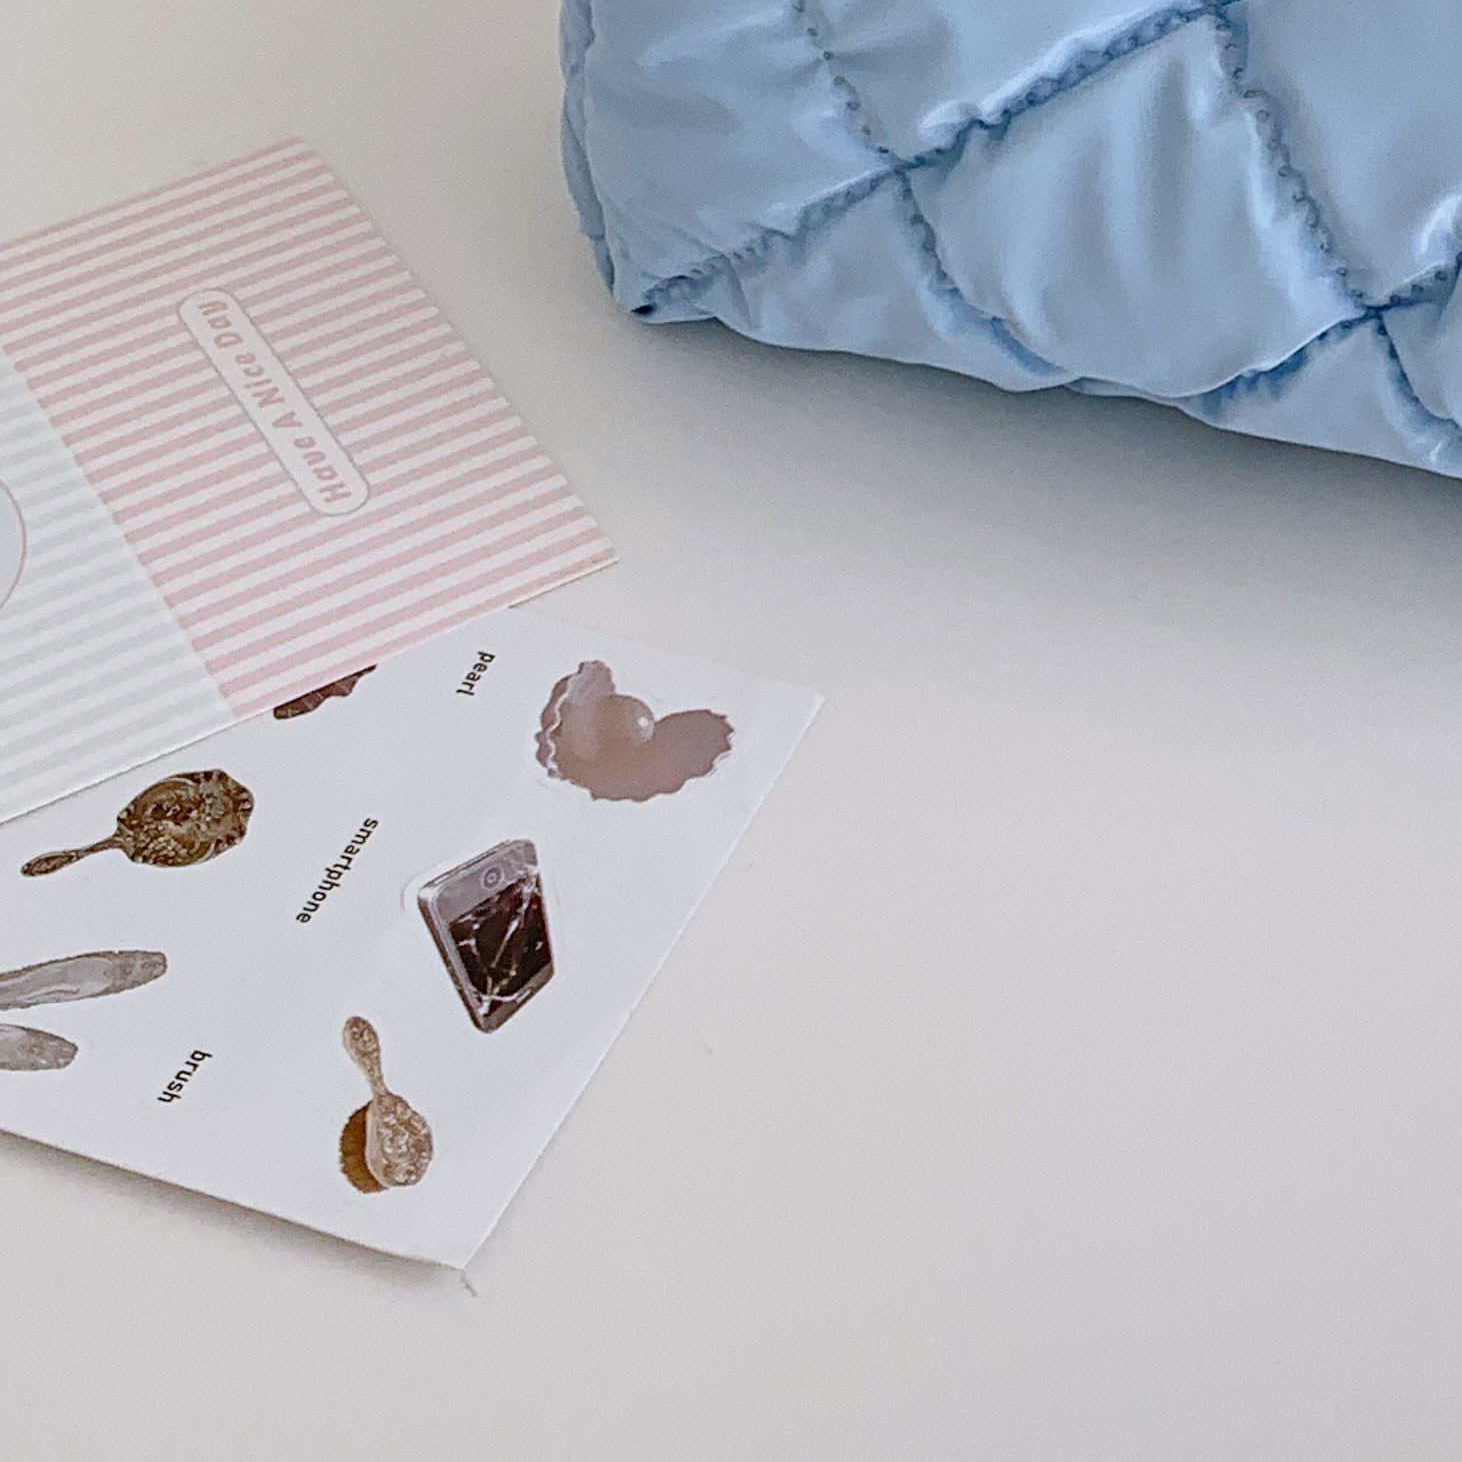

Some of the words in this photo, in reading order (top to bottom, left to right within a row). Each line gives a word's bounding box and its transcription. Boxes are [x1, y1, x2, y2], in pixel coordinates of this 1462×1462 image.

[197, 299, 244, 349] Day
[234, 352, 285, 409] Nice
[271, 410, 304, 428] A
[293, 435, 353, 503] Have
[456, 651, 496, 696] pearl
[295, 817, 379, 923] smartphone
[157, 1049, 213, 1103] brush
